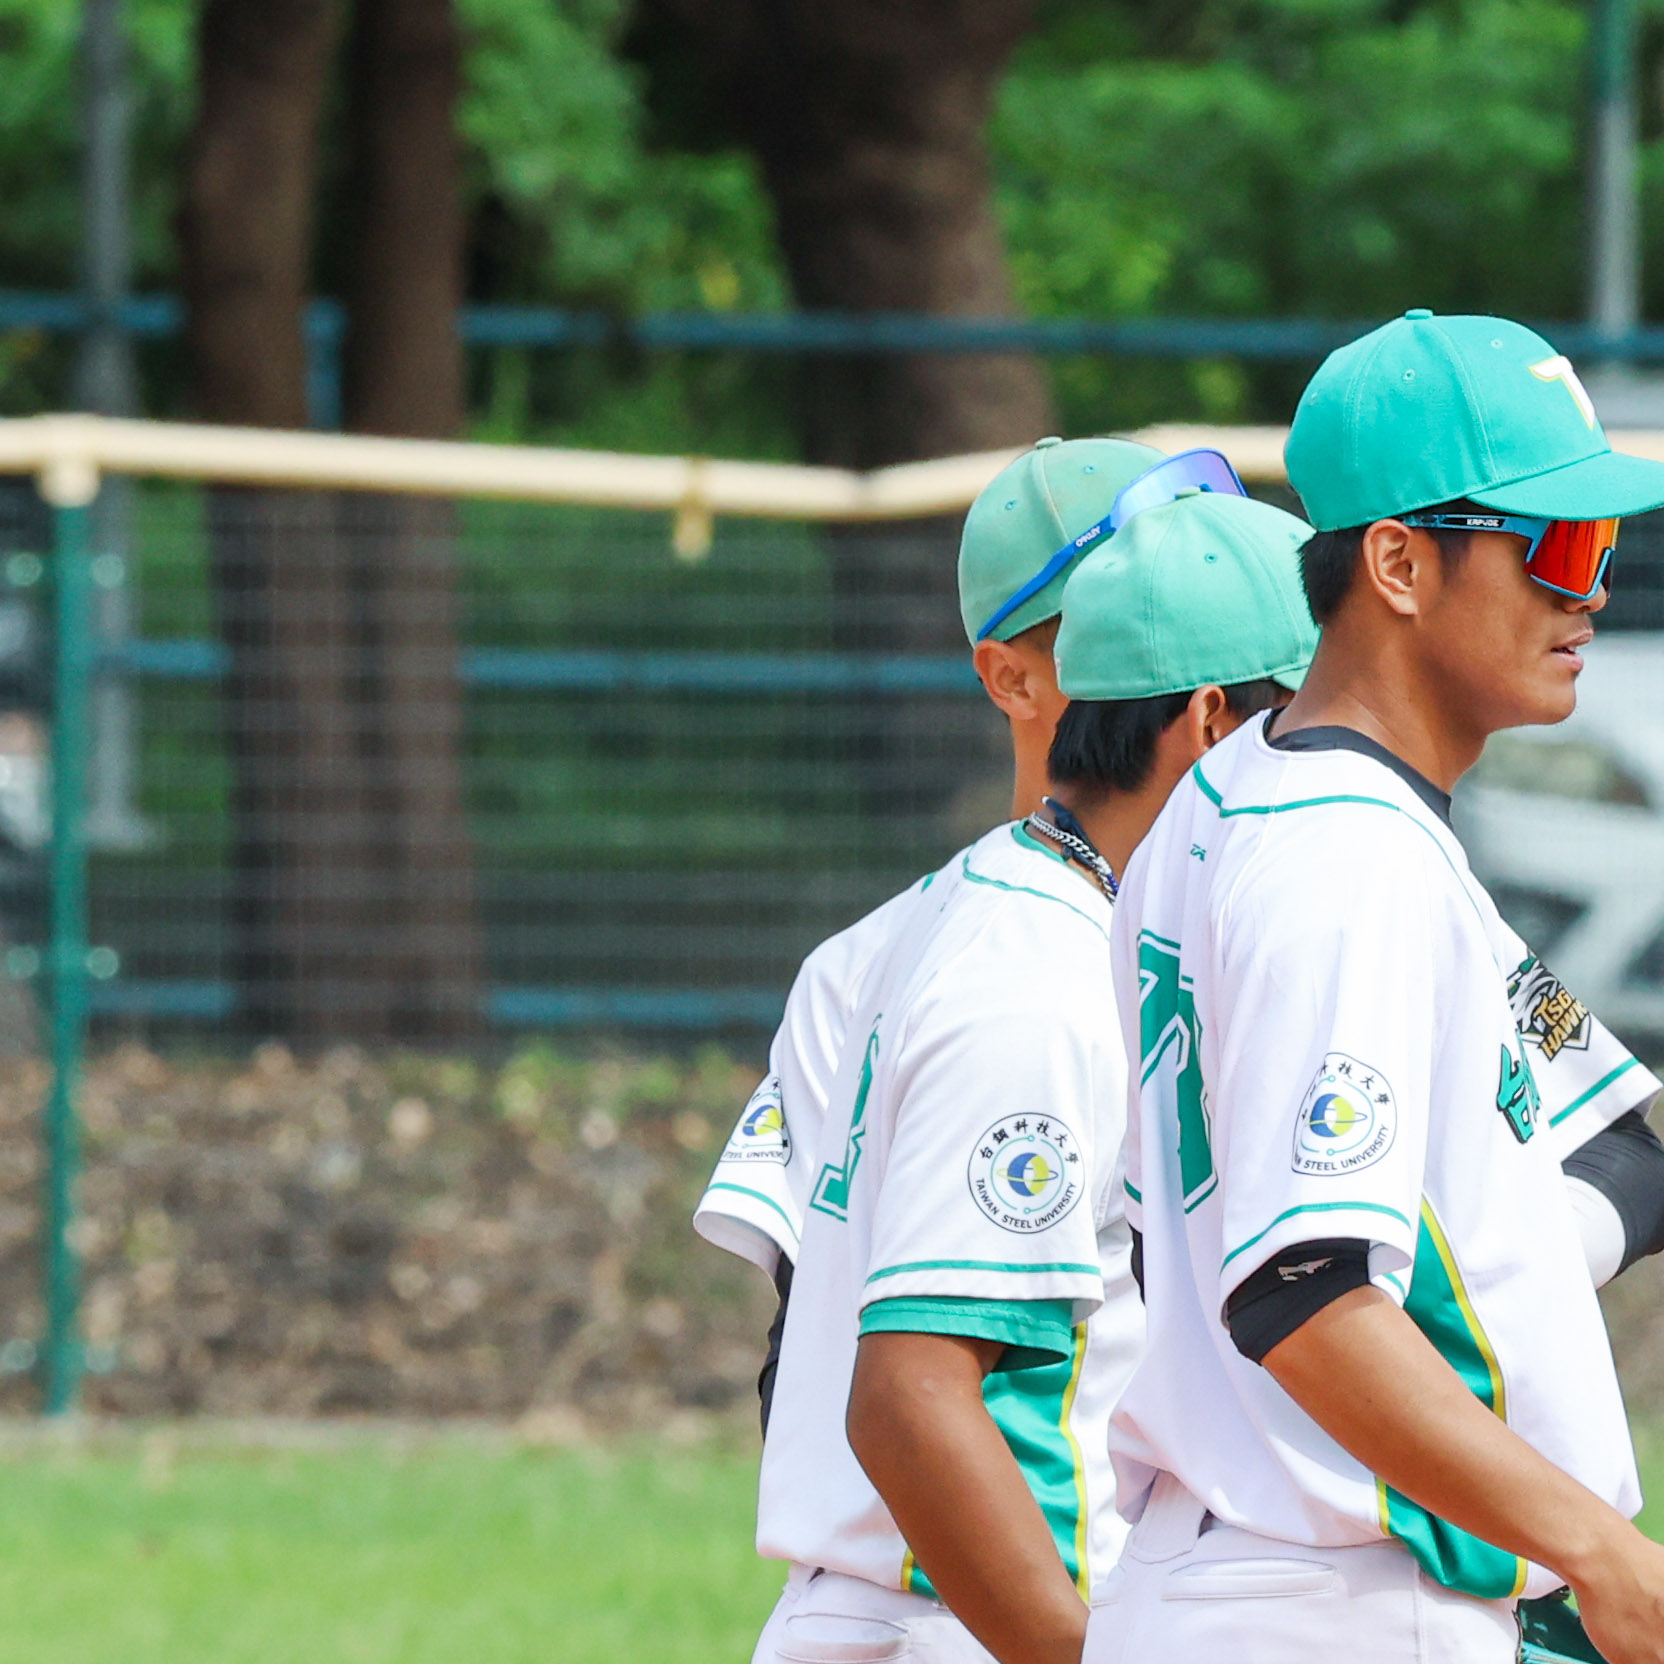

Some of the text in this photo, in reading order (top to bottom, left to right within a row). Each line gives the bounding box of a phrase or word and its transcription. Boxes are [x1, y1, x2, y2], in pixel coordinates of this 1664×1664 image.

[1540, 999, 1591, 1061] HAWK
[1303, 1124, 1389, 1171] STEEL UNIVERSITY
[975, 1177, 1076, 1229] TAIWAN STEEL UNIVERSITY
